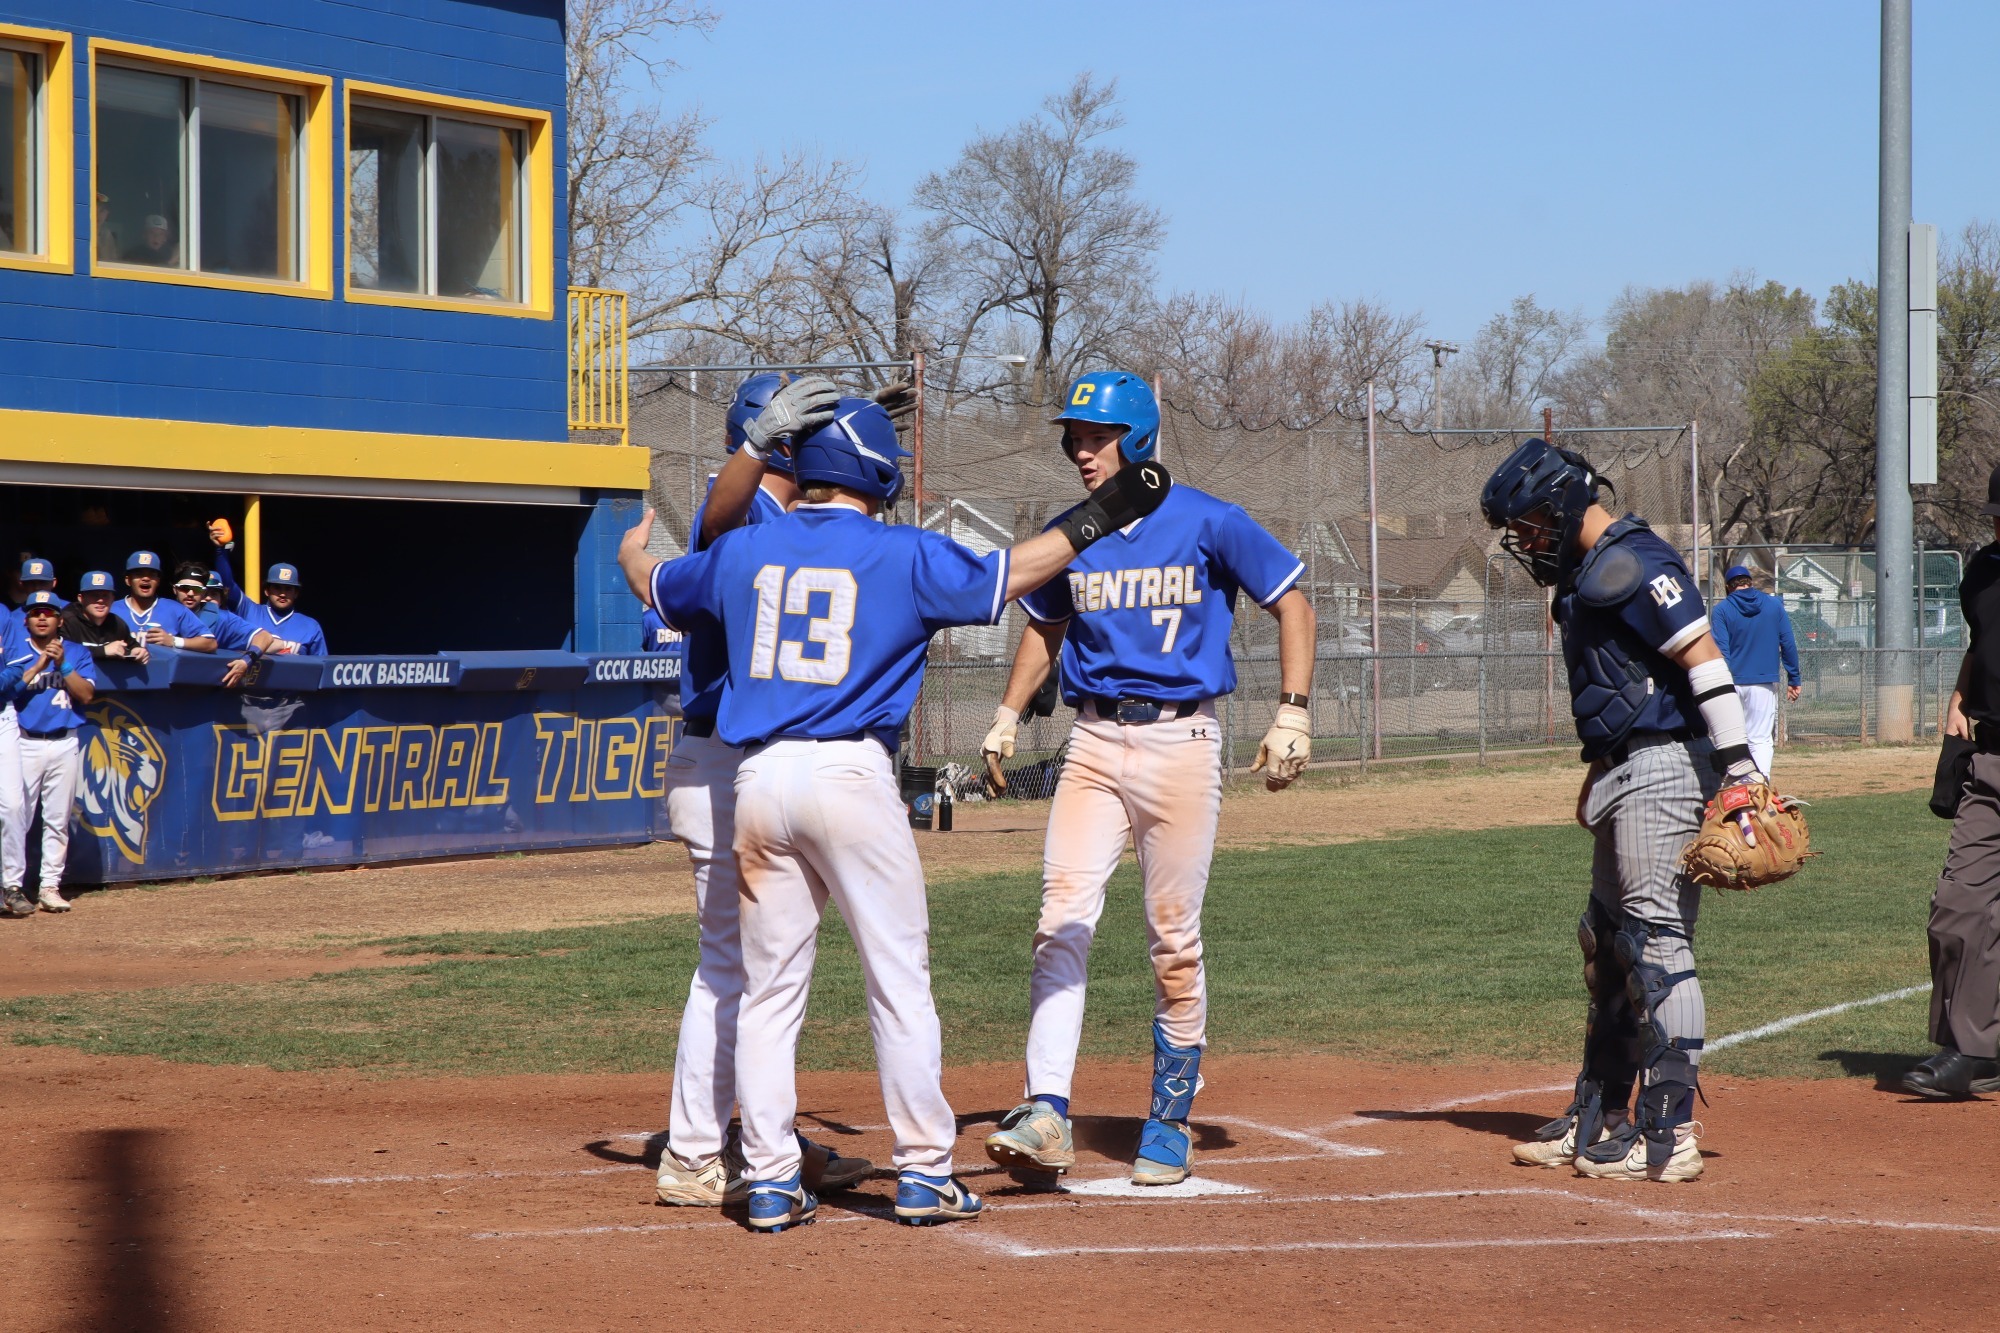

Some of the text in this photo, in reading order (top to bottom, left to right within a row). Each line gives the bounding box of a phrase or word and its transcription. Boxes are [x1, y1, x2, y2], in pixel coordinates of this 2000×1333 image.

[1071, 383, 1096, 406] C
[1068, 565, 1202, 613] CENTRAL
[749, 564, 858, 686] 13
[1151, 608, 1182, 653] 7
[332, 662, 450, 686] CCCK BASEBALL
[594, 658, 682, 681] CCCK BASEBA
[212, 722, 510, 822] CENTRAL
